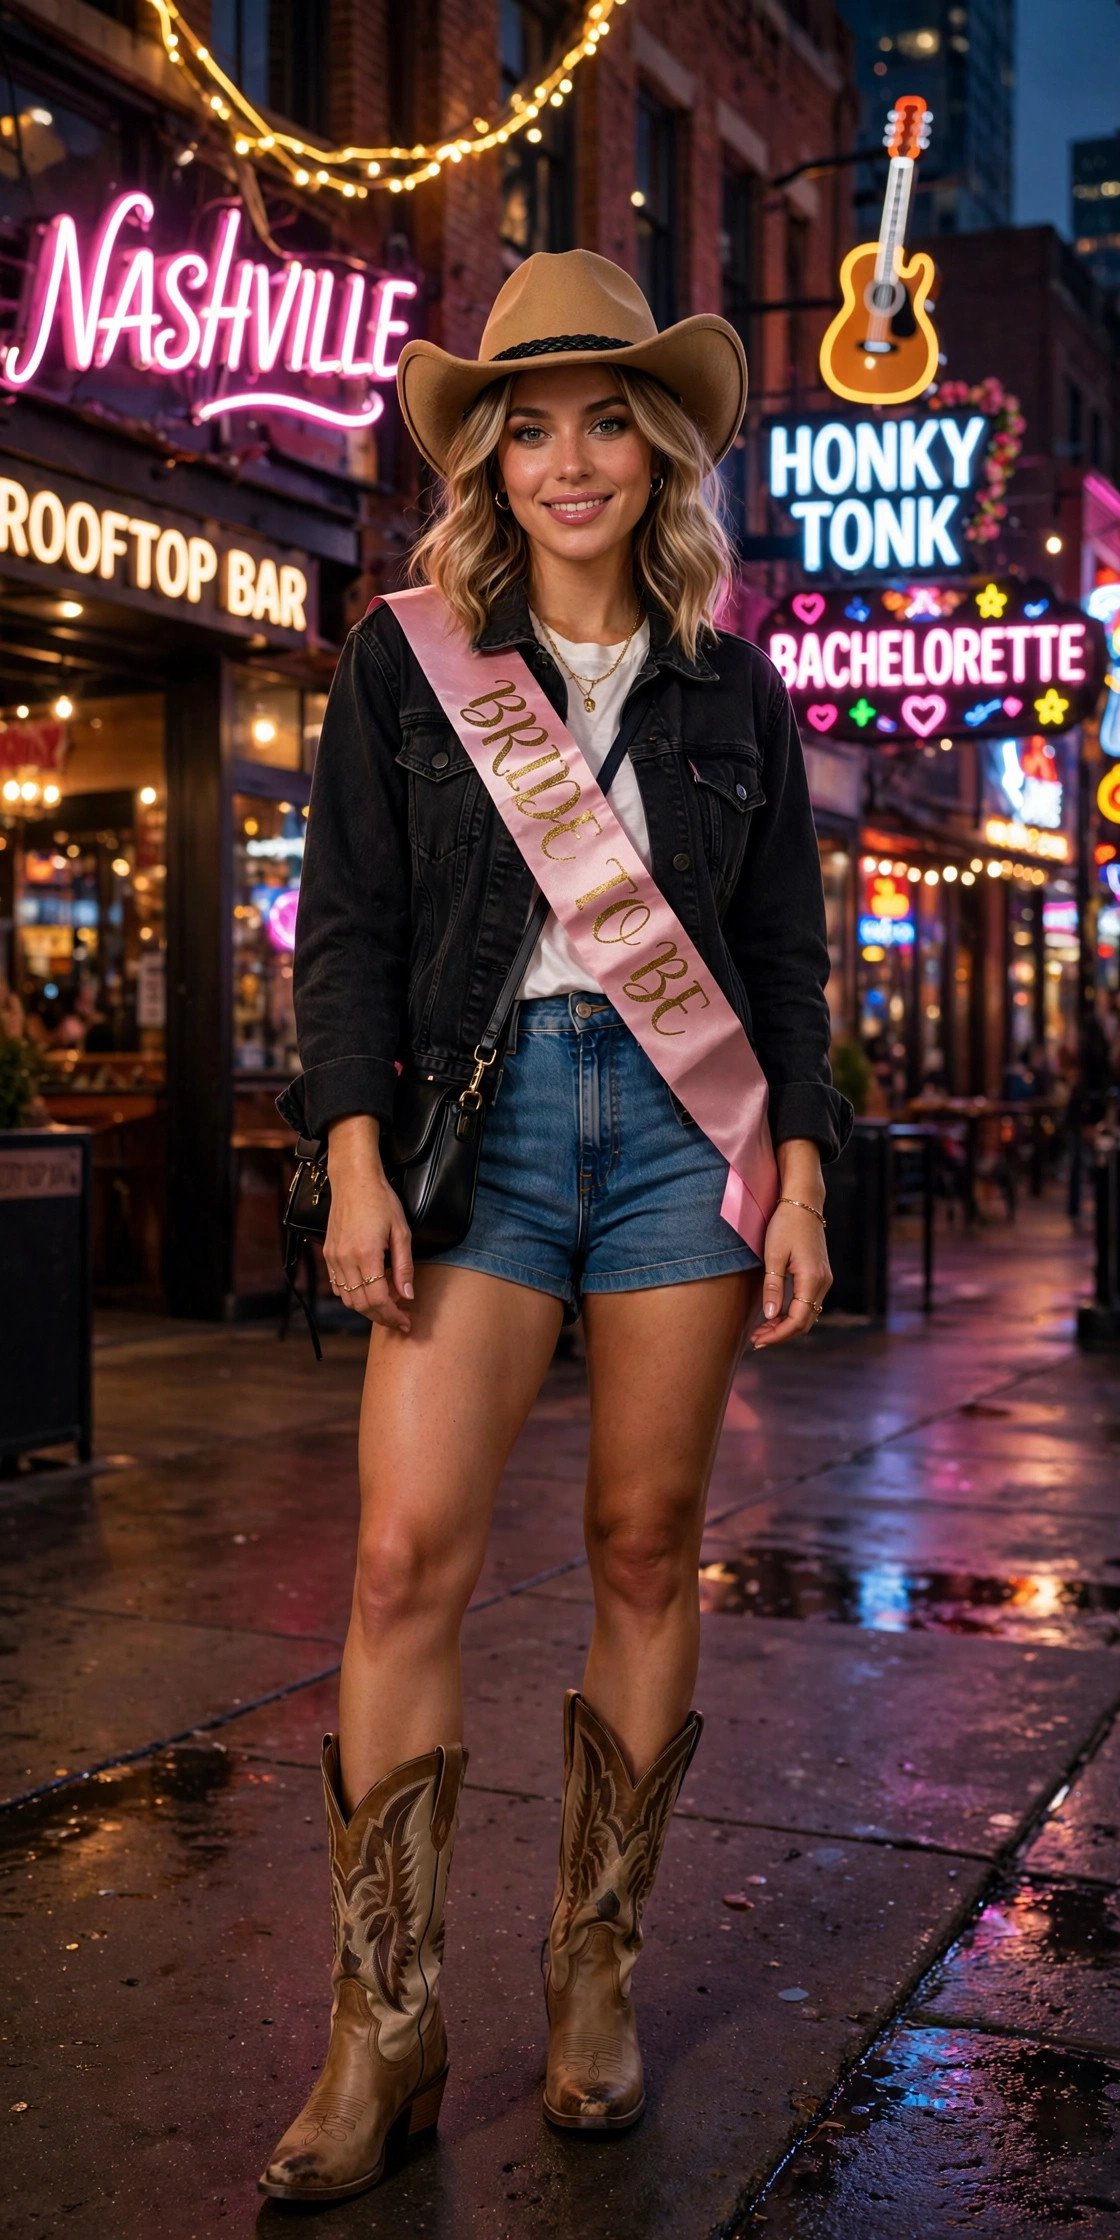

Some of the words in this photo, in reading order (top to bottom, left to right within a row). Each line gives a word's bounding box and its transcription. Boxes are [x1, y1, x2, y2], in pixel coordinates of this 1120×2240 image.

[4, 192, 417, 384] NASHVILLE
[769, 415, 985, 497] HONKY
[0, 477, 217, 603] ROOFTOP
[227, 548, 307, 632] BAR
[790, 494, 961, 571] TONK
[769, 623, 1086, 689] BACHELORETTE
[460, 680, 602, 861] BRIDE
[575, 858, 650, 946] TO
[622, 942, 710, 1036] BE
